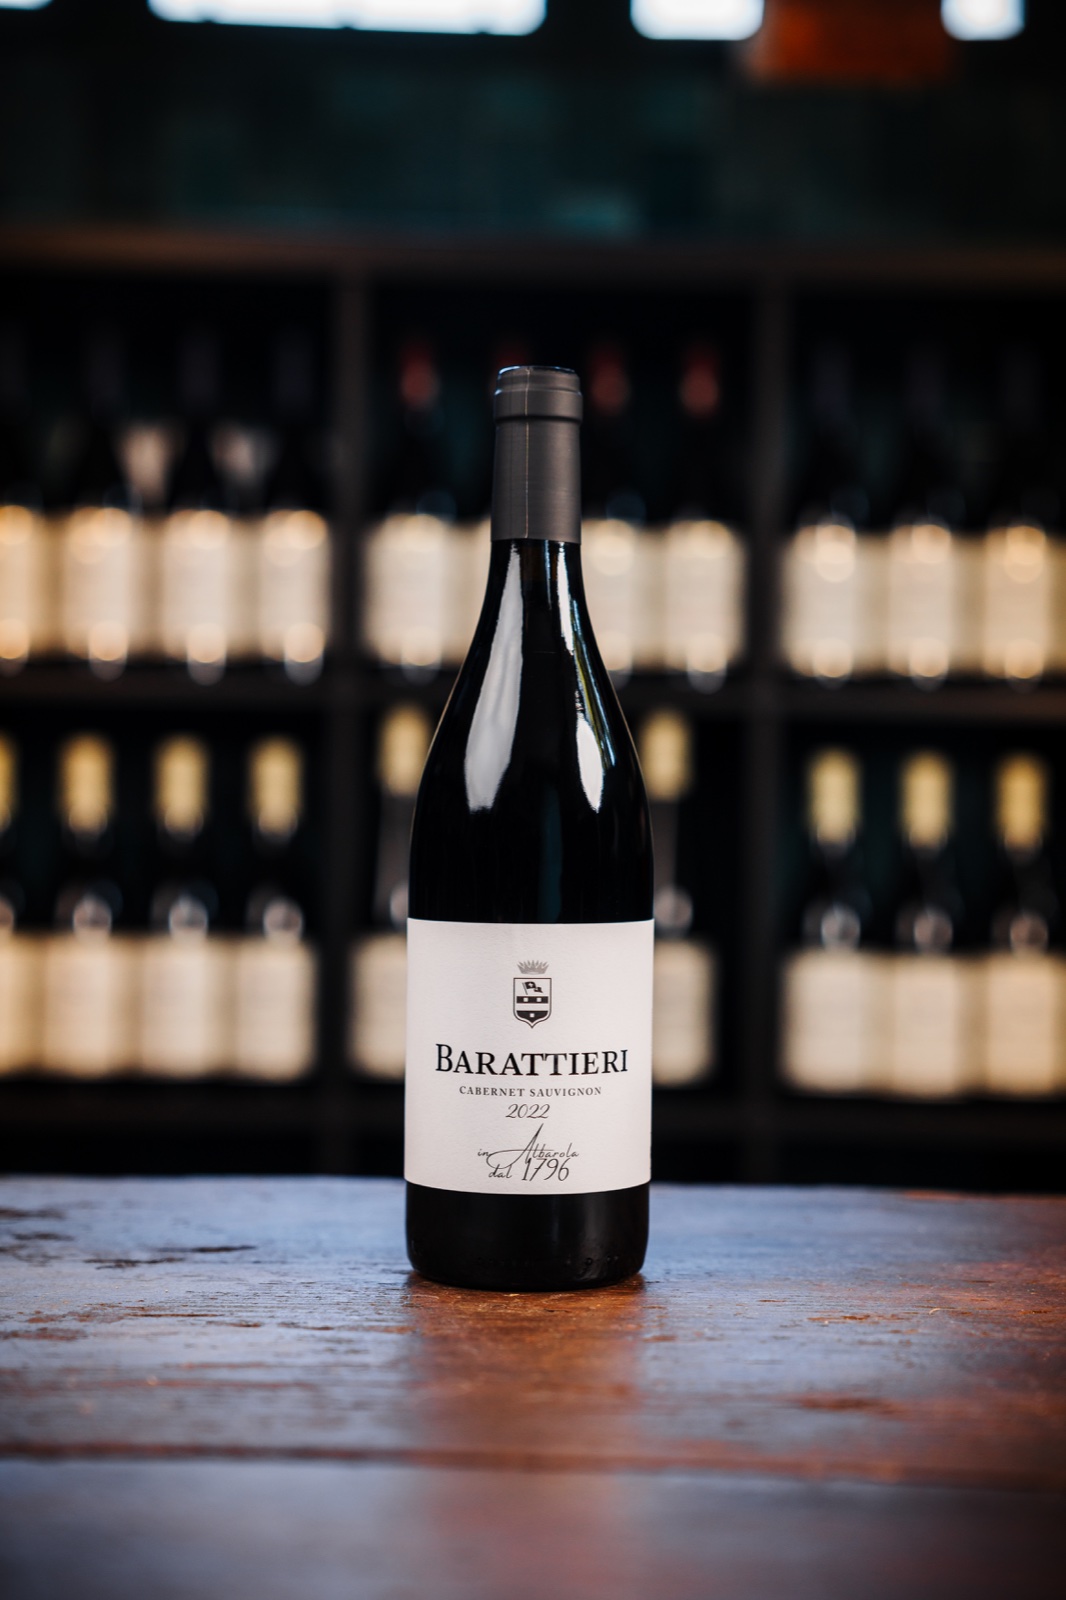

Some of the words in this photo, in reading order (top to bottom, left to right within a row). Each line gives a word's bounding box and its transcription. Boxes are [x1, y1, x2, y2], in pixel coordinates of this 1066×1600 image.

[435, 1043, 628, 1076] BARATTIERI
[459, 1085, 525, 1097] CABERNET
[529, 1086, 602, 1097] SAUVIGNON
[505, 1103, 550, 1118] 2022
[477, 1148, 489, 1157] in
[486, 1123, 579, 1169] Albarola
[488, 1163, 512, 1178] dal
[521, 1157, 571, 1181] 1796
